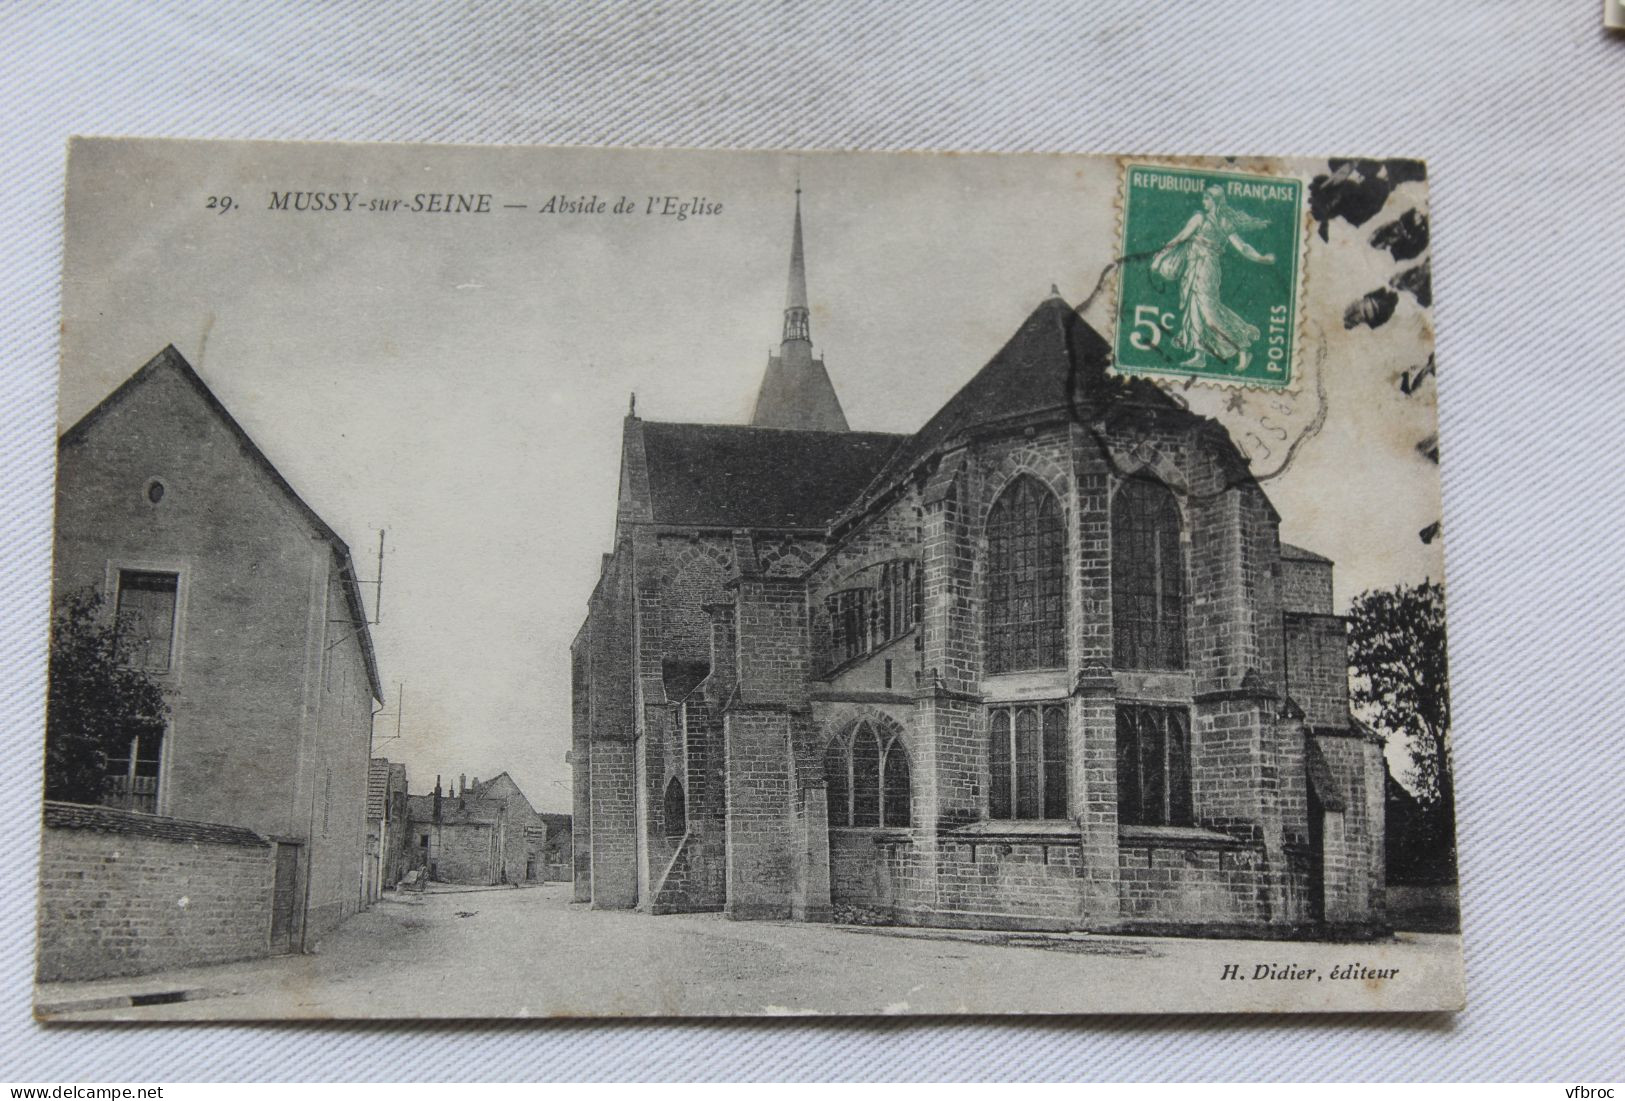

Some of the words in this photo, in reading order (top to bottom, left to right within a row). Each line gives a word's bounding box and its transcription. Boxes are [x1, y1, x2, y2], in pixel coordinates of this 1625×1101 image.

[1227, 181, 1294, 201] FRANÇAISE
[205, 196, 240, 215] 29.
[267, 191, 493, 213] MUSSY-sur-SEINE
[539, 194, 606, 215] Abside
[612, 195, 635, 215] de
[645, 196, 724, 222] l'Eglise
[1266, 304, 1287, 373] POSTES
[1220, 964, 1246, 981] H.
[1252, 963, 1323, 983] Didier,
[1329, 962, 1400, 981] éditeur
